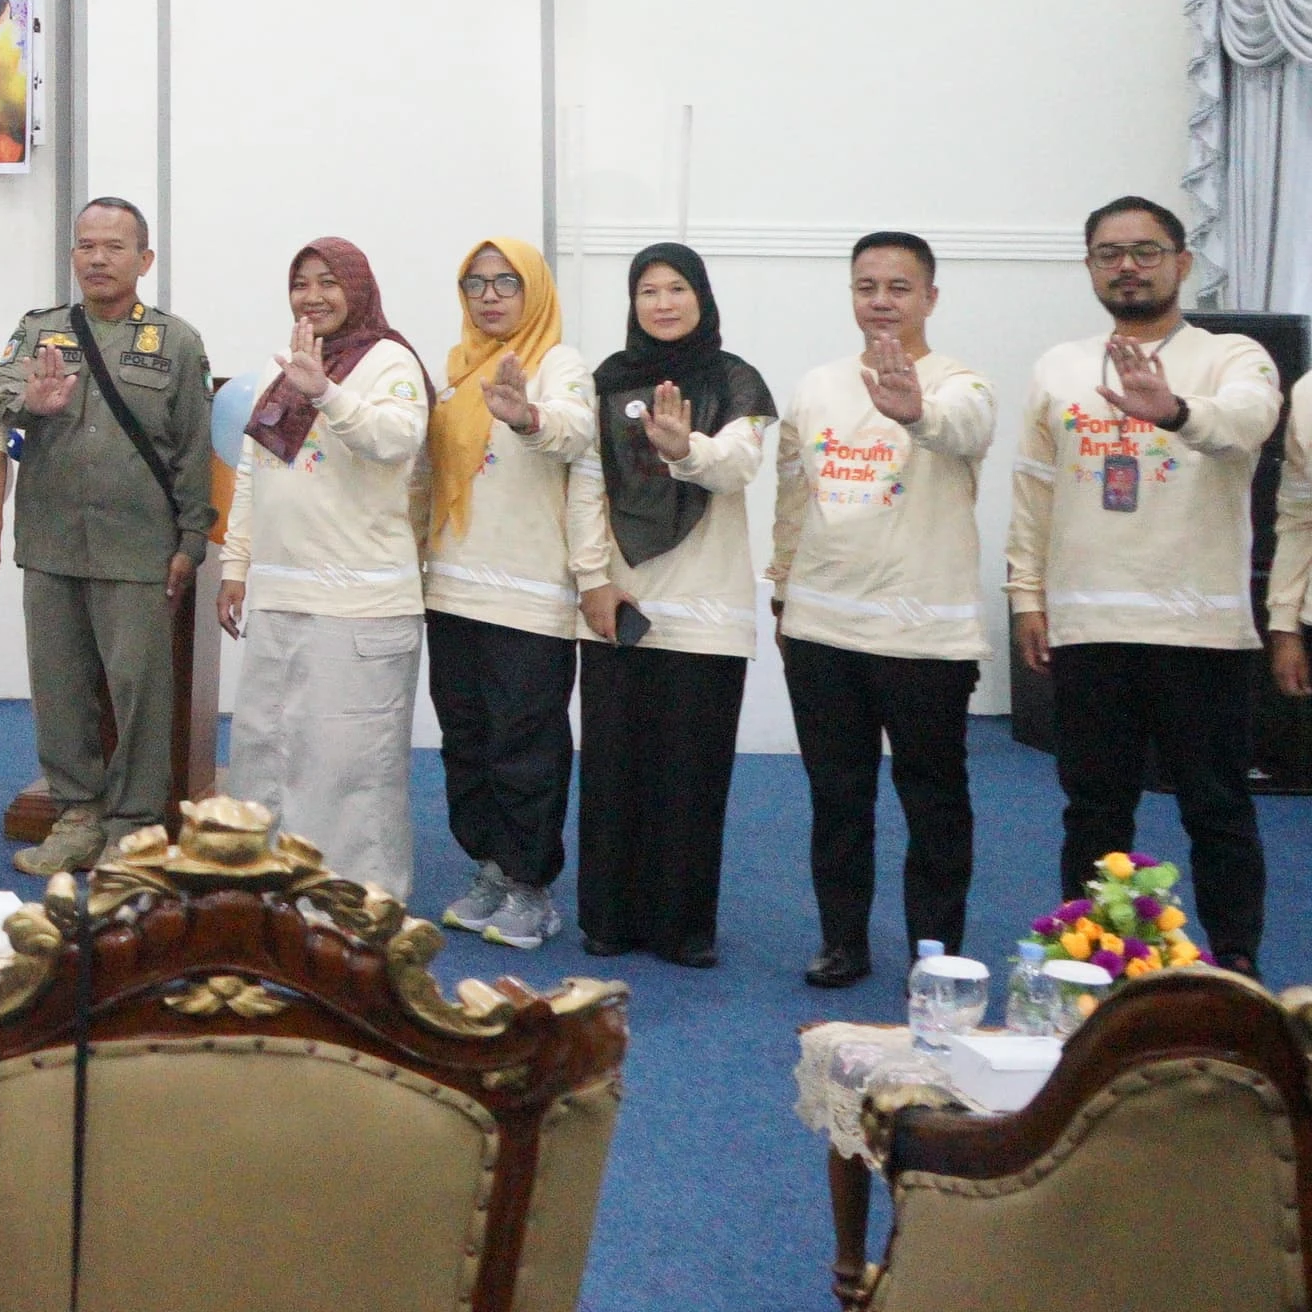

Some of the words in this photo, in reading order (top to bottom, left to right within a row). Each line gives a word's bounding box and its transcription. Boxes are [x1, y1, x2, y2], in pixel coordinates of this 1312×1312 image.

[123, 354, 148, 366] POL
[152, 358, 170, 369] PP
[1074, 413, 1154, 434] Forum
[823, 439, 894, 462] Forum
[1079, 436, 1139, 457] Anak
[820, 460, 876, 482] Anak
